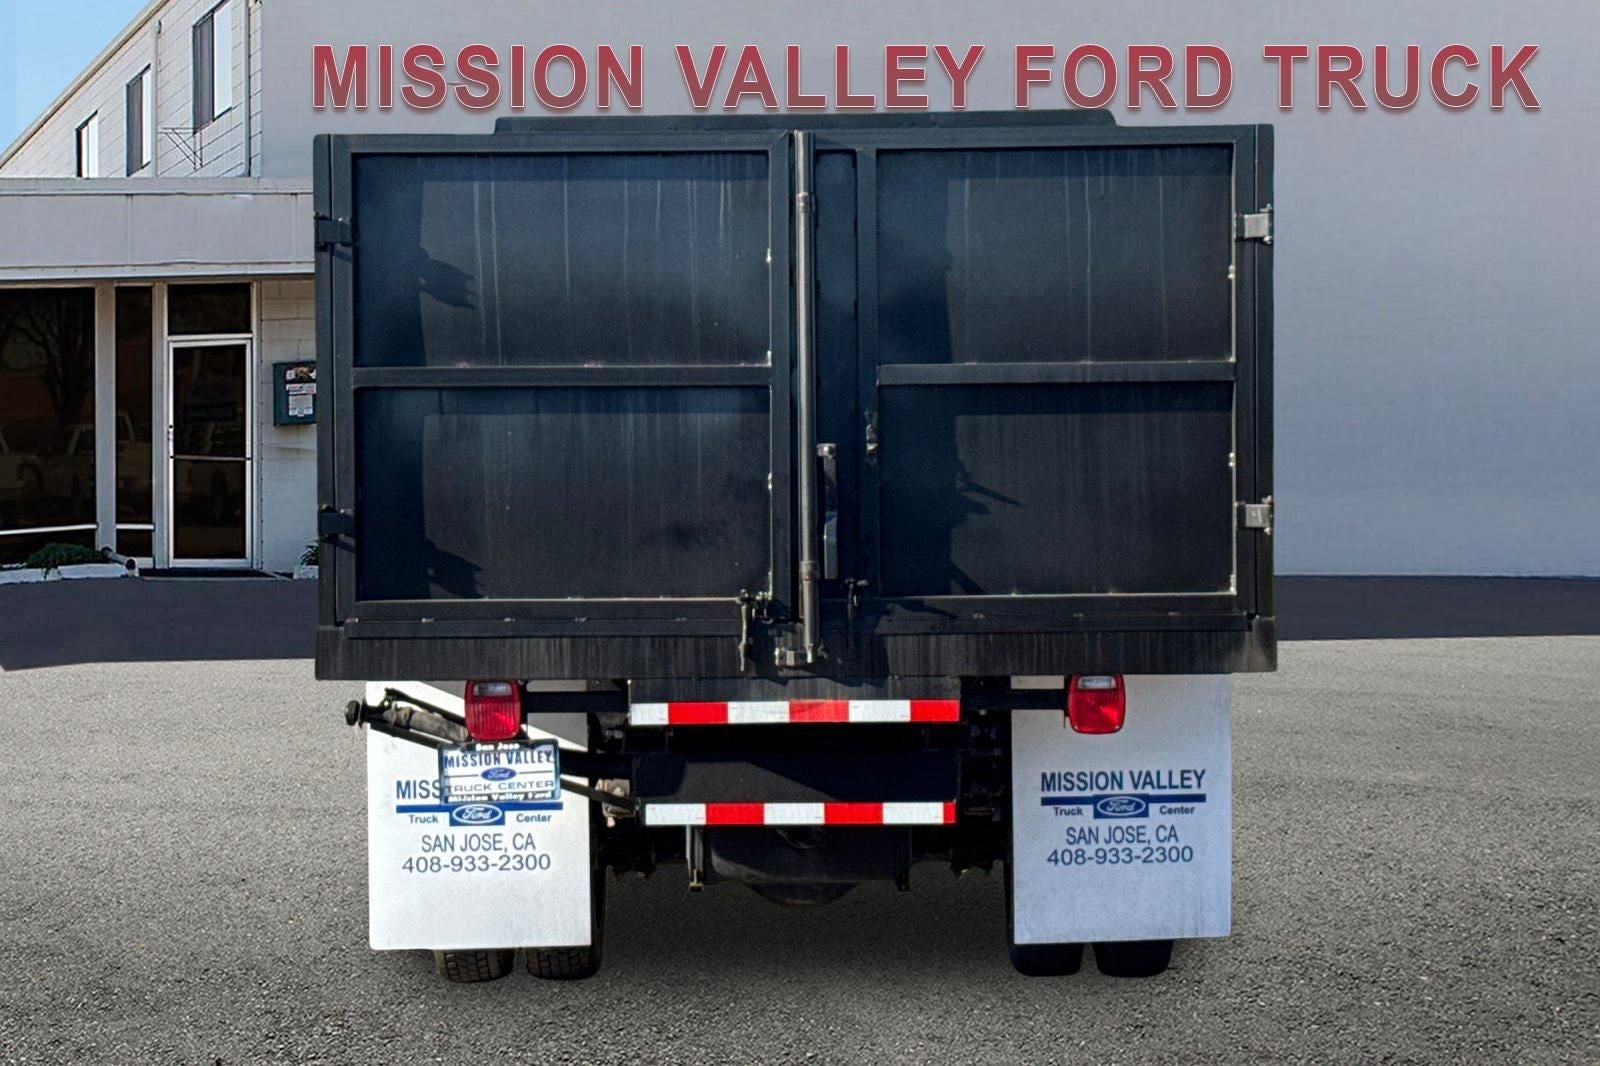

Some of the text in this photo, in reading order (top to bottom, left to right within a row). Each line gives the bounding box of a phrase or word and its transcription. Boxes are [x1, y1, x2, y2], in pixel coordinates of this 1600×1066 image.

[445, 750, 552, 768] MISSION VALLEY
[488, 769, 509, 779] Ford
[1041, 769, 1206, 792] MISSION VALLEY
[396, 780, 440, 800] MISS
[445, 781, 554, 792] TRUCK CENTER
[408, 806, 552, 824] Truck Ford Center
[1054, 799, 1195, 816] Truck Ford Center
[422, 832, 536, 854] SAN JOSE, CA
[1066, 824, 1178, 846] SAN JOSE, CA
[402, 854, 551, 874] 408-933-2300
[1047, 846, 1193, 866] 408-933-2300
